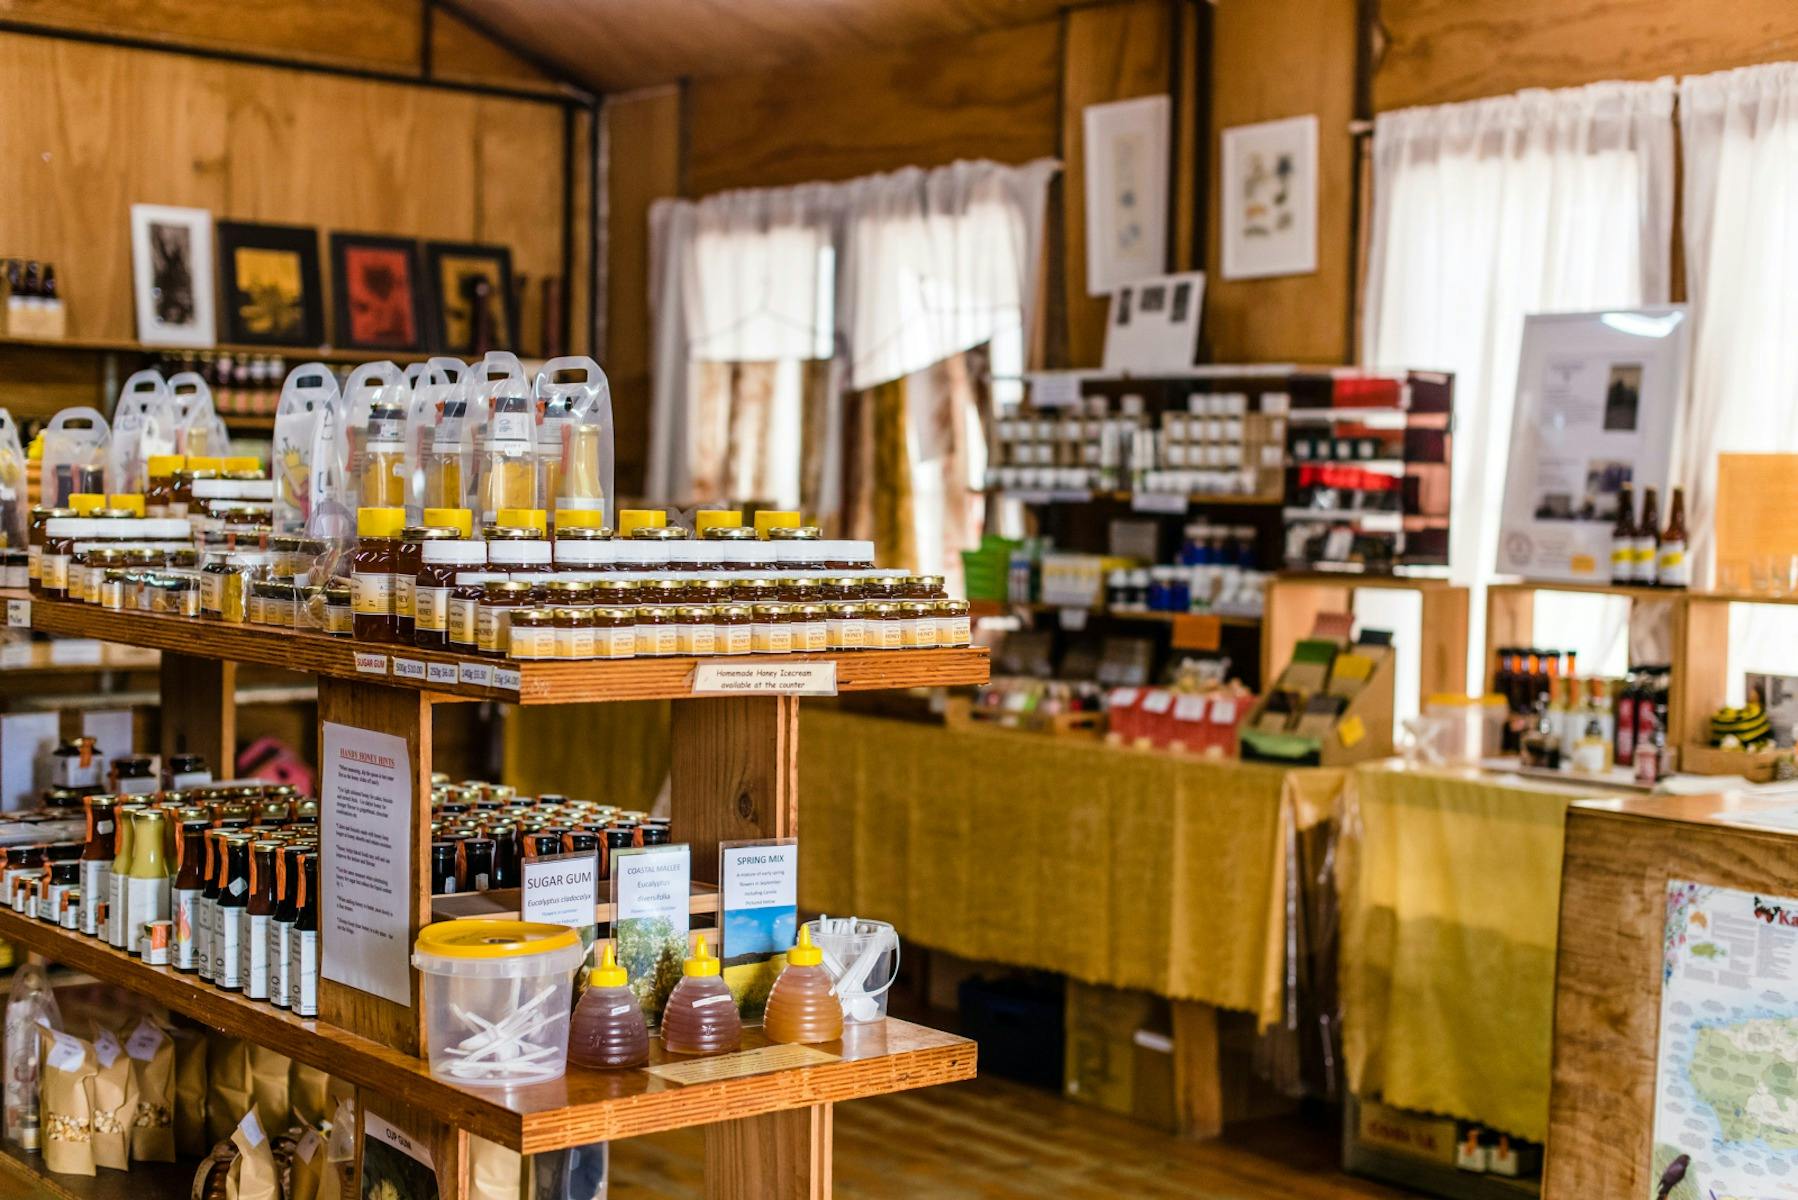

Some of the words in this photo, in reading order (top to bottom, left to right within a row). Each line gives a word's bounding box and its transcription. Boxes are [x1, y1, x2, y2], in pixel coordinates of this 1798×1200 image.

[357, 658, 373, 667] SUGAR
[374, 659, 385, 668] GUM
[716, 669, 753, 677] Homemade
[756, 669, 777, 678] Honey
[780, 669, 812, 677] Icecream
[721, 681, 751, 689] available
[359, 751, 377, 763] HONEY
[736, 855, 767, 866] SPRING
[769, 854, 785, 863] MIX
[627, 865, 655, 875] COASTAL
[656, 864, 681, 873] MALLEE
[527, 874, 564, 890] SUGAR
[566, 871, 592, 884] GUM
[527, 896, 560, 908] Eucalyptus
